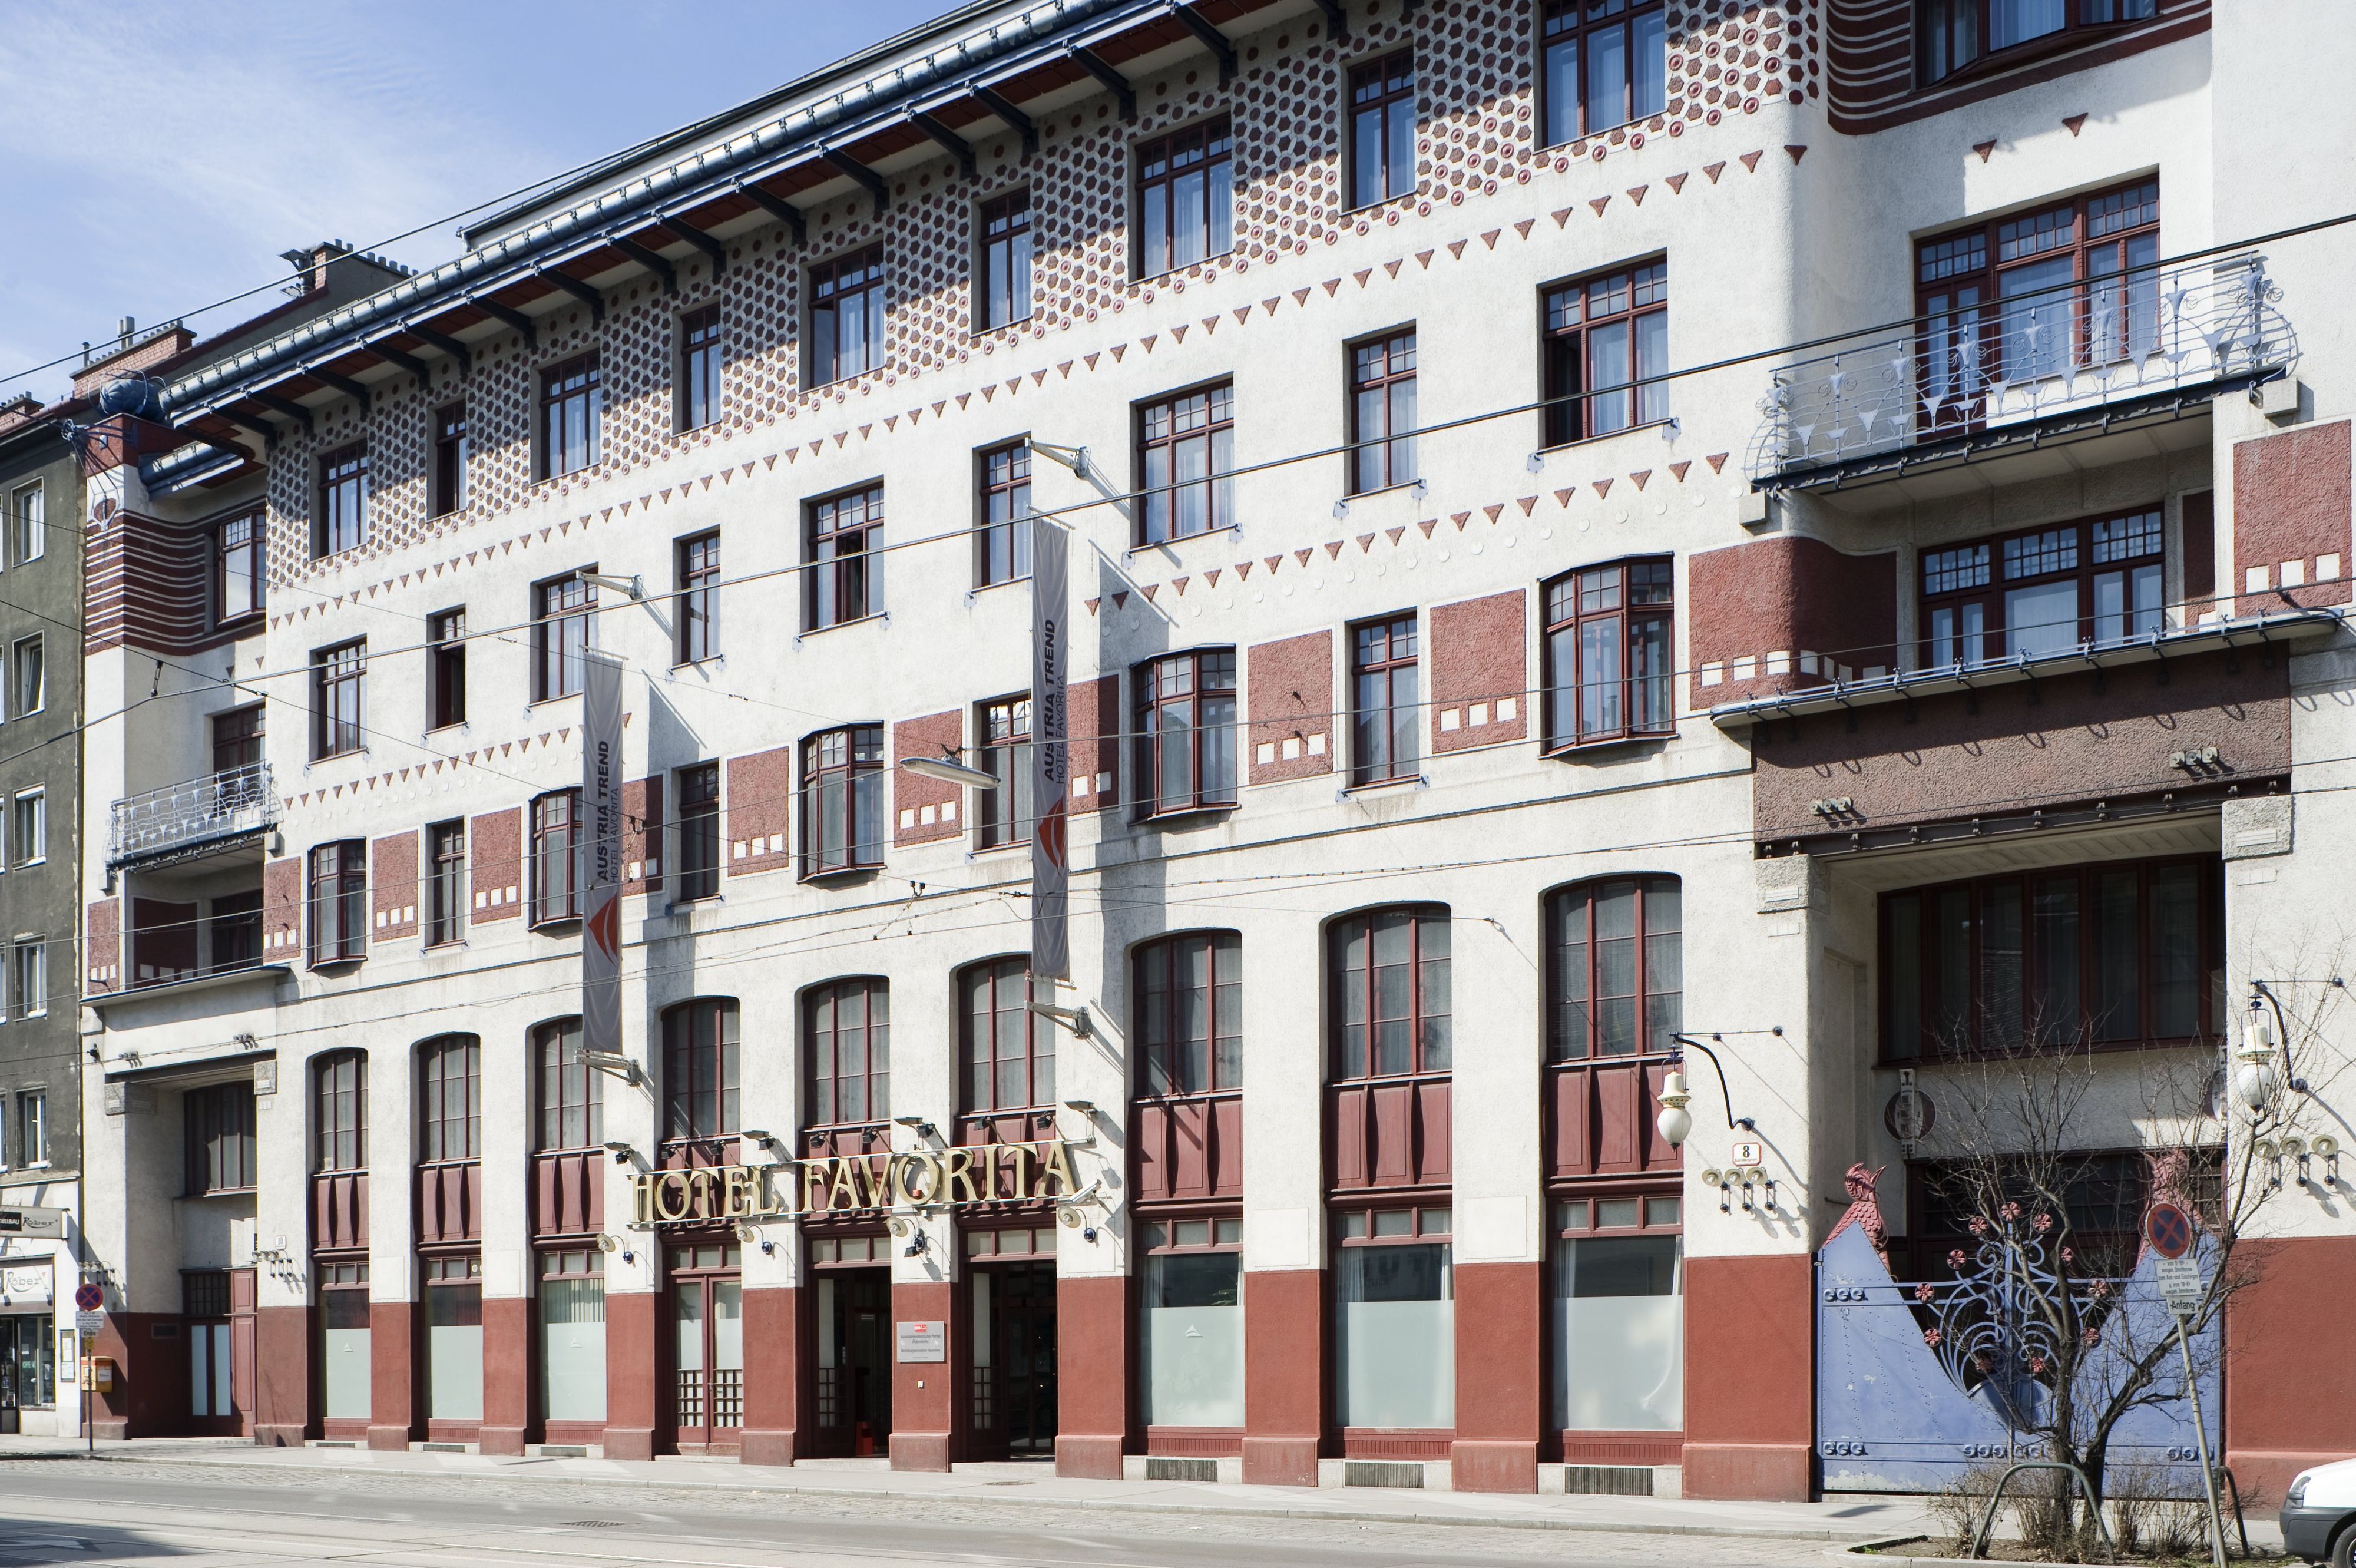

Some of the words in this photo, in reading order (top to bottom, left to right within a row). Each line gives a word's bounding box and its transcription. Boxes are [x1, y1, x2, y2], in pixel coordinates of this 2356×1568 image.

[1045, 620, 1055, 687] TREND
[1044, 693, 1055, 782] AUSTRIA
[1055, 676, 1064, 739] FAVORITA
[598, 740, 609, 799] TREND
[1055, 740, 1064, 785] HOTEL
[597, 805, 608, 882] AUSTRIA
[610, 788, 618, 843] FAVORITA
[610, 849, 618, 884] HOTEL
[1743, 1145, 1750, 1158] 8
[630, 1165, 780, 1223] HOTEL
[801, 1143, 1077, 1212] FAVORITA
